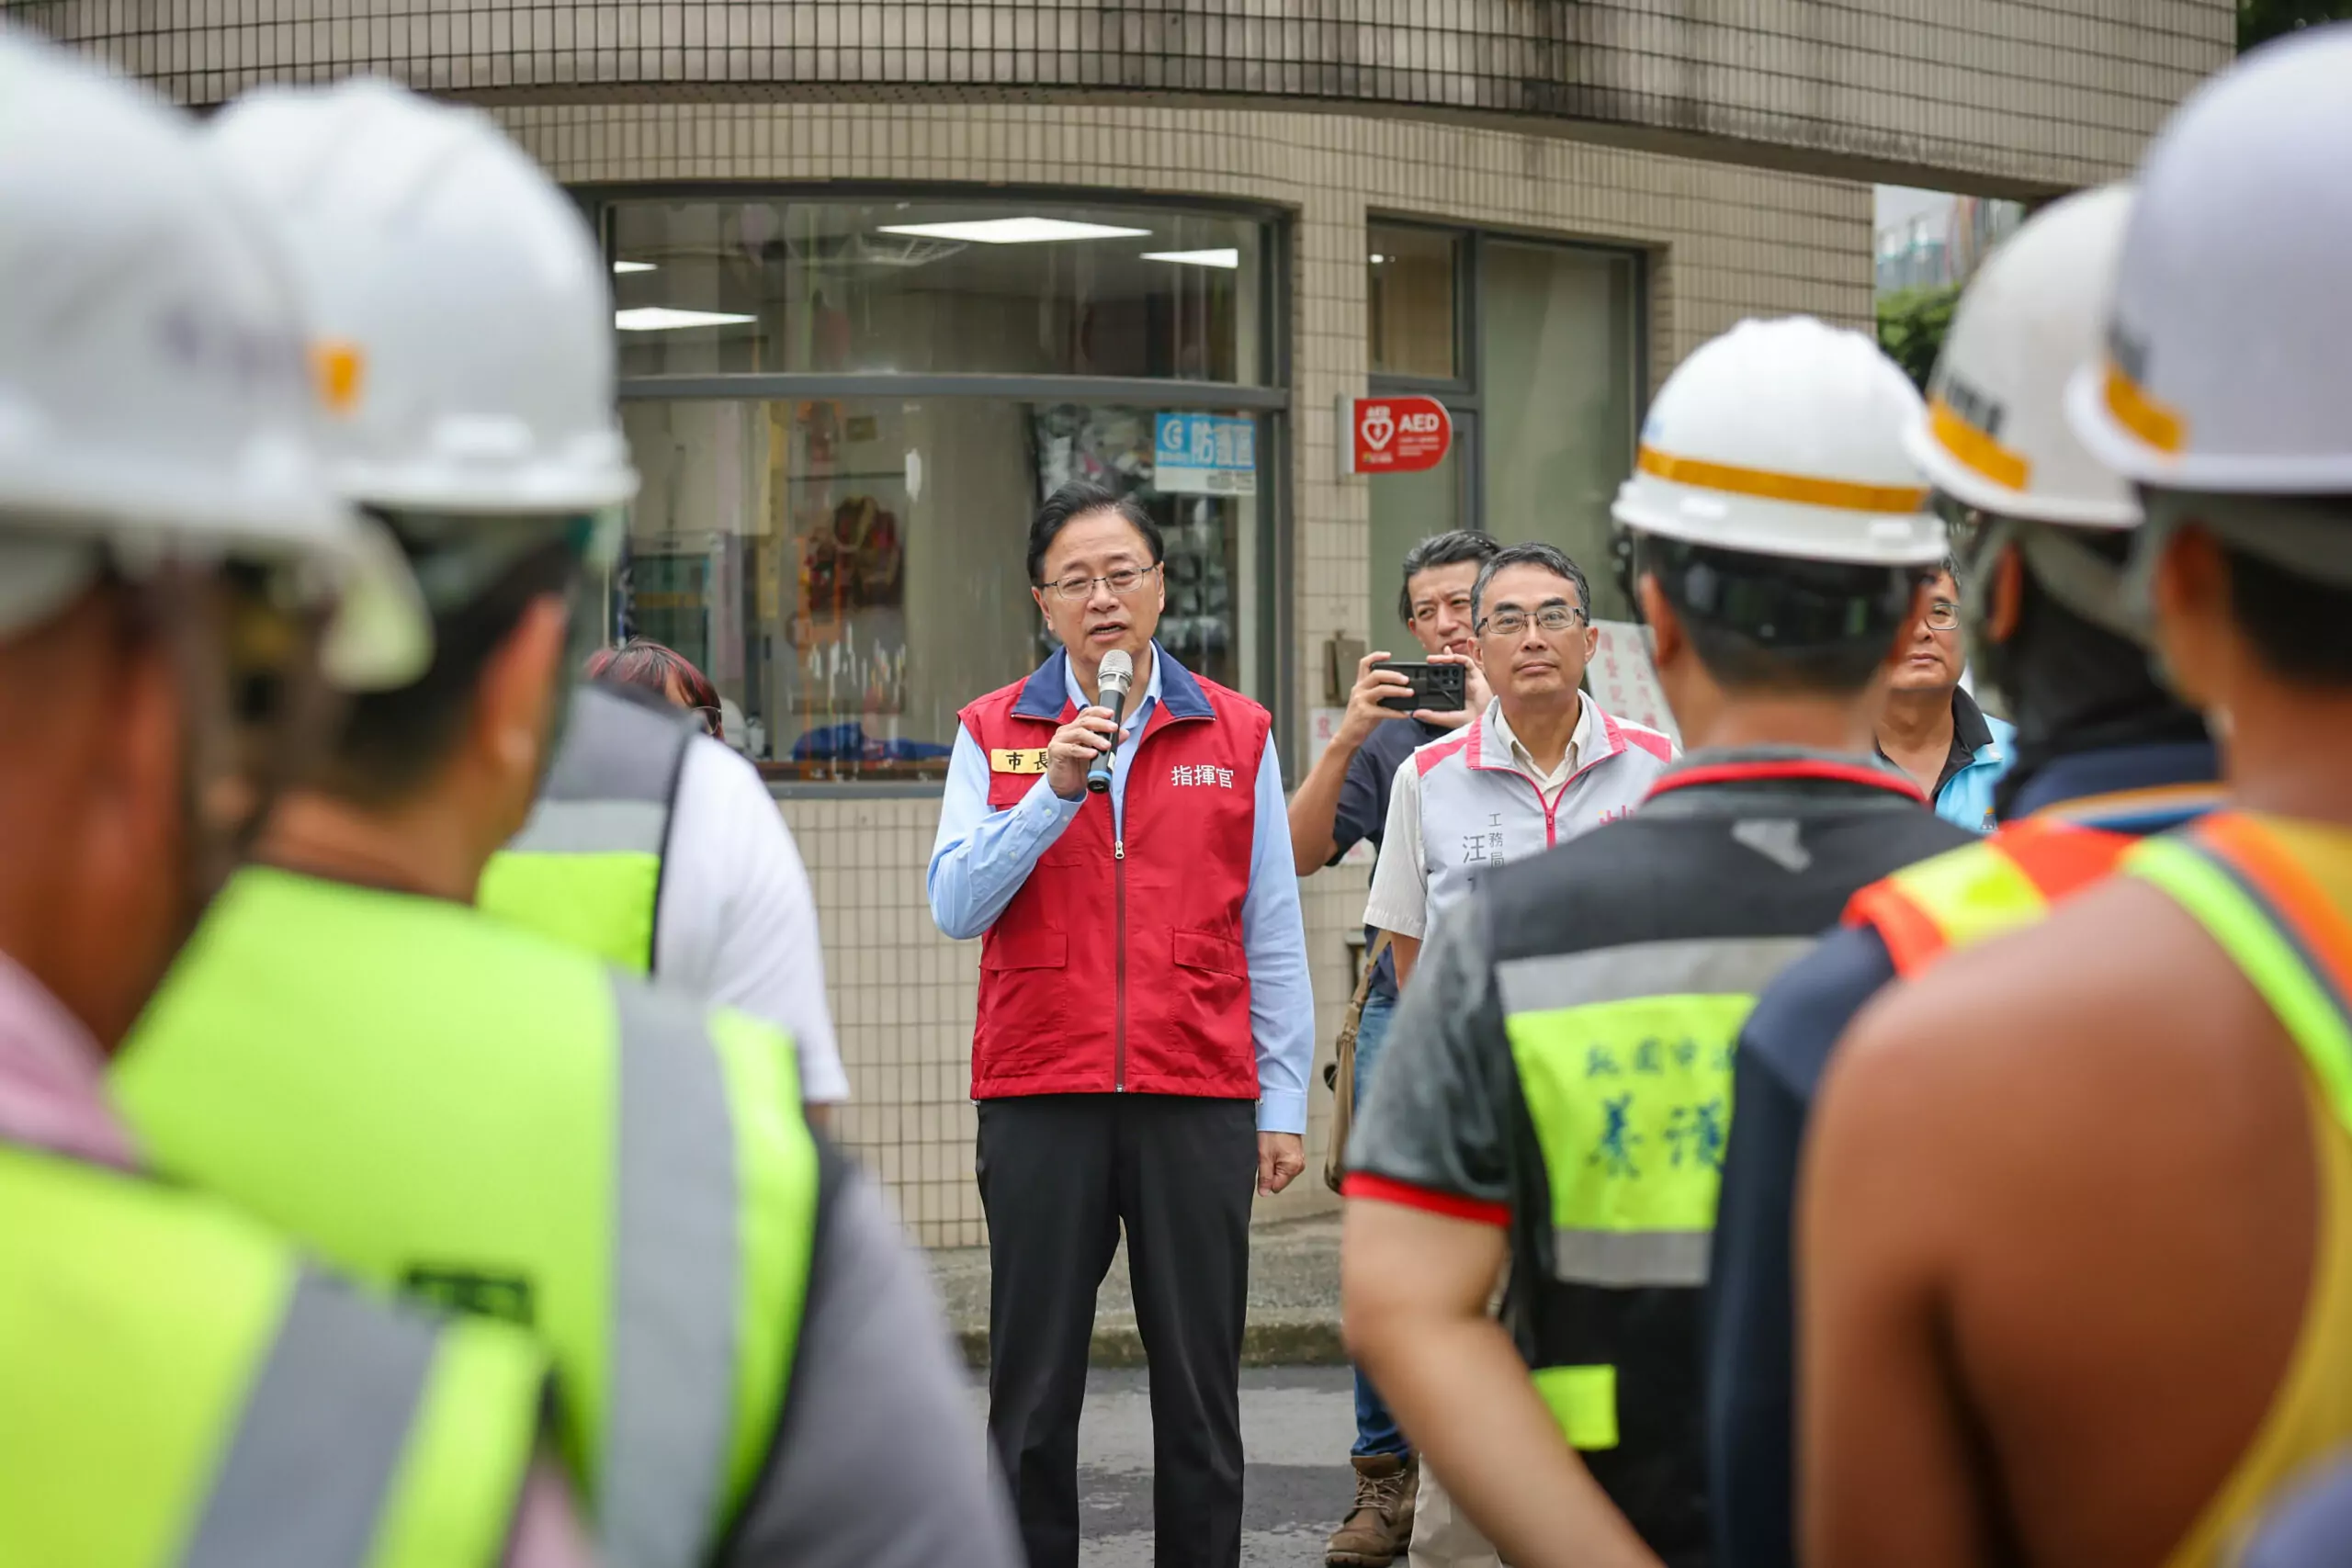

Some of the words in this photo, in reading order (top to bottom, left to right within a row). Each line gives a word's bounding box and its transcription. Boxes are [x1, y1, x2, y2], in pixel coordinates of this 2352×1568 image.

[1398, 412, 1440, 433] AED
[1005, 751, 1047, 771] 市長
[1170, 764, 1234, 789] 指揮官
[1488, 812, 1504, 867] 工務局
